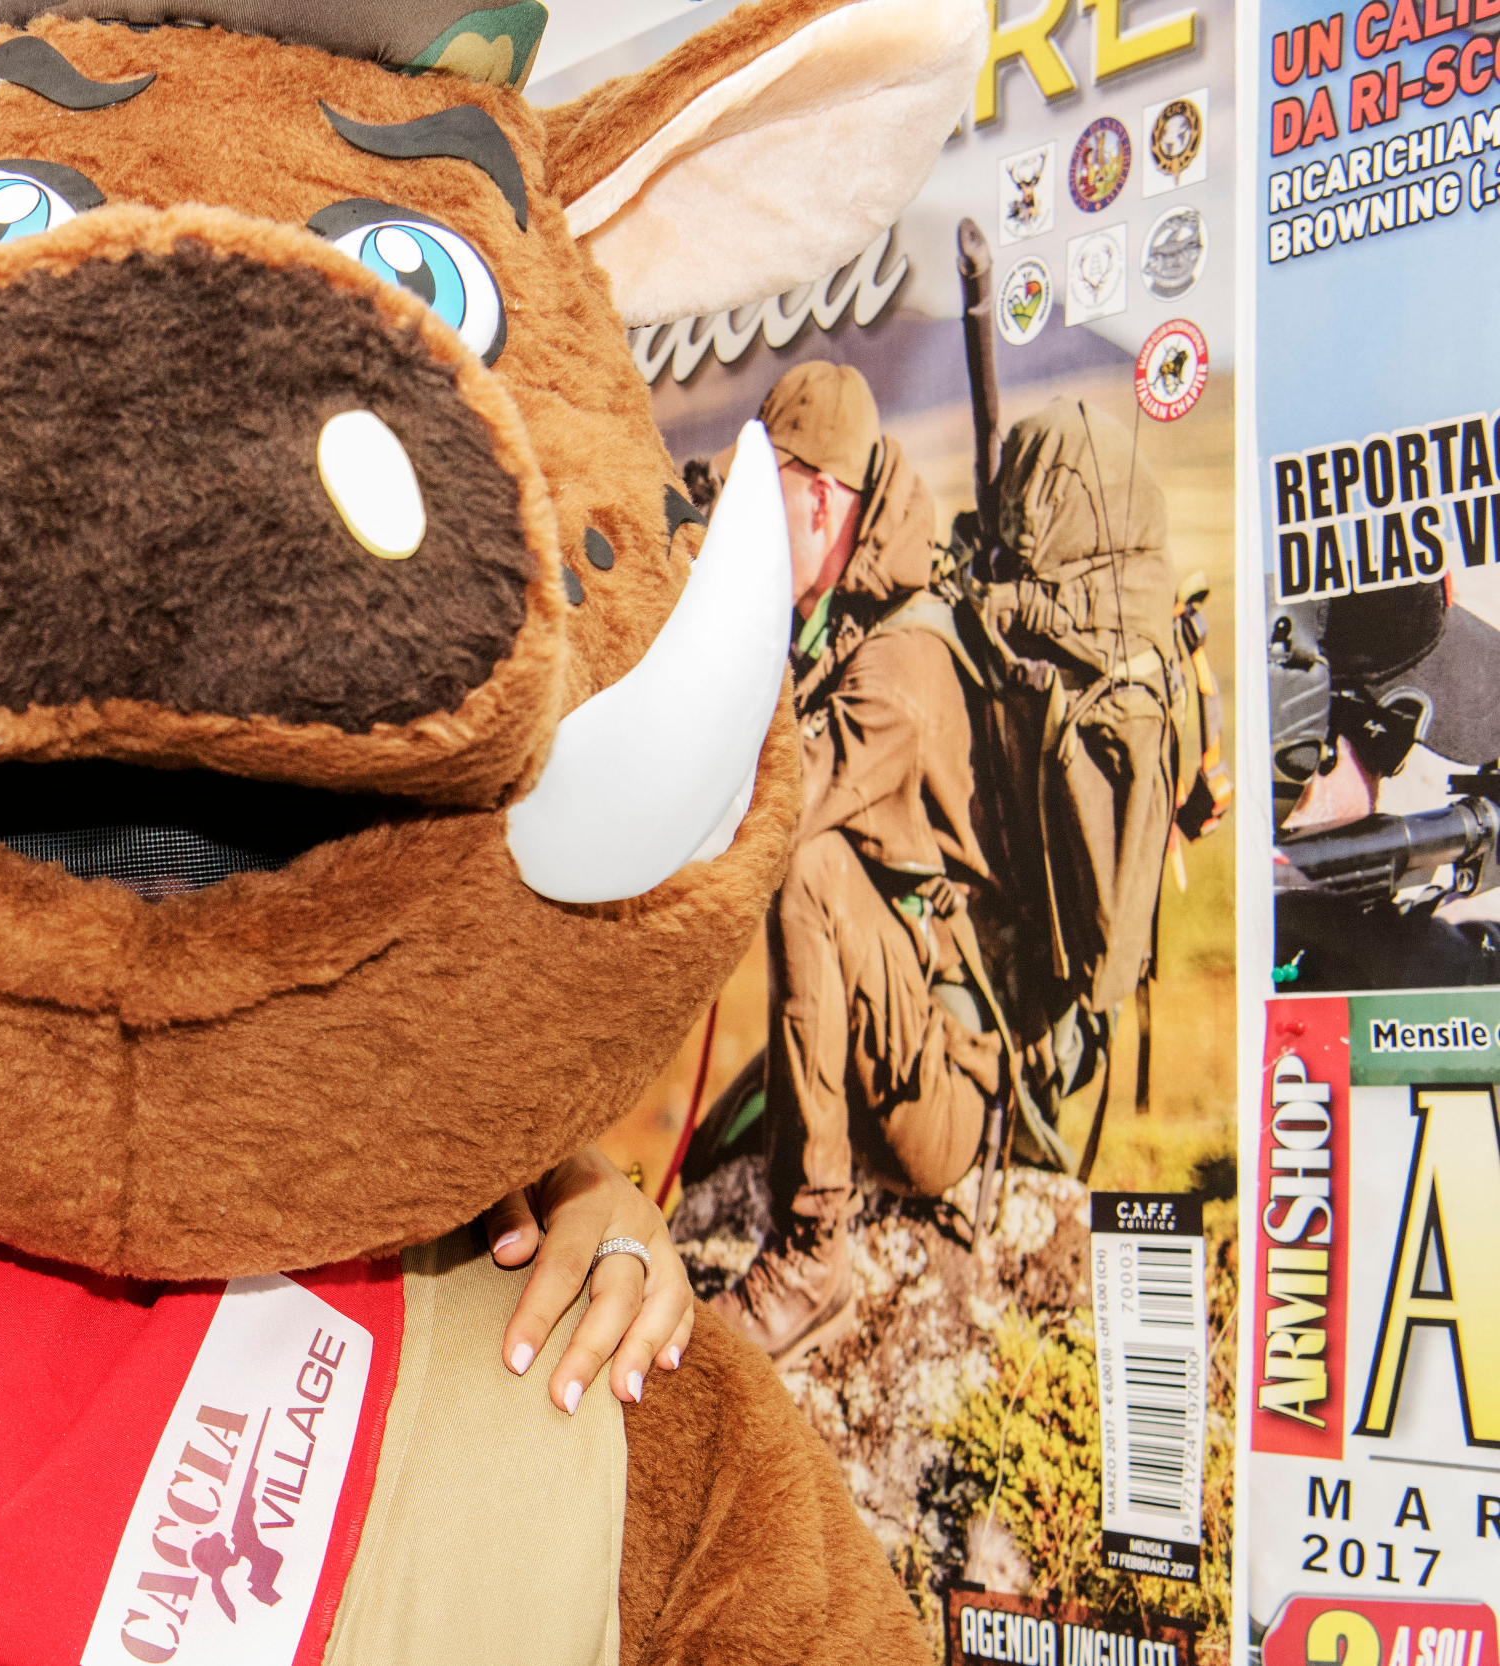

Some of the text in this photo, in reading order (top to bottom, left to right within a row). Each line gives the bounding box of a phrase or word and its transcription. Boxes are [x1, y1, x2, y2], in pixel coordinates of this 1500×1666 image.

[1272, 13, 1344, 85] UN
[1271, 33, 1500, 156] DA RI-SC
[1269, 172, 1462, 264] BROWNING
[1135, 364, 1209, 419] ITALIAN CHAPTER
[1275, 417, 1500, 526] REPORTA
[1278, 494, 1500, 597] DA LAS V
[1372, 1020, 1488, 1049] Mensile
[1118, 1219, 1177, 1231] editrice
[1120, 1242, 1134, 1314] 70003
[260, 1327, 346, 1529] VILLAGE
[1105, 1421, 1116, 1453] 2017
[1106, 1459, 1117, 1515] MARZO
[120, 1404, 248, 1664] CACCIA
[1129, 1538, 1173, 1559] MENSILE
[1301, 1533, 1442, 1587] 2017
[1107, 1551, 1196, 1579] 17 FEBBRAIO 2017
[961, 1606, 1056, 1666] AGENDA
[1389, 1625, 1411, 1666] A
